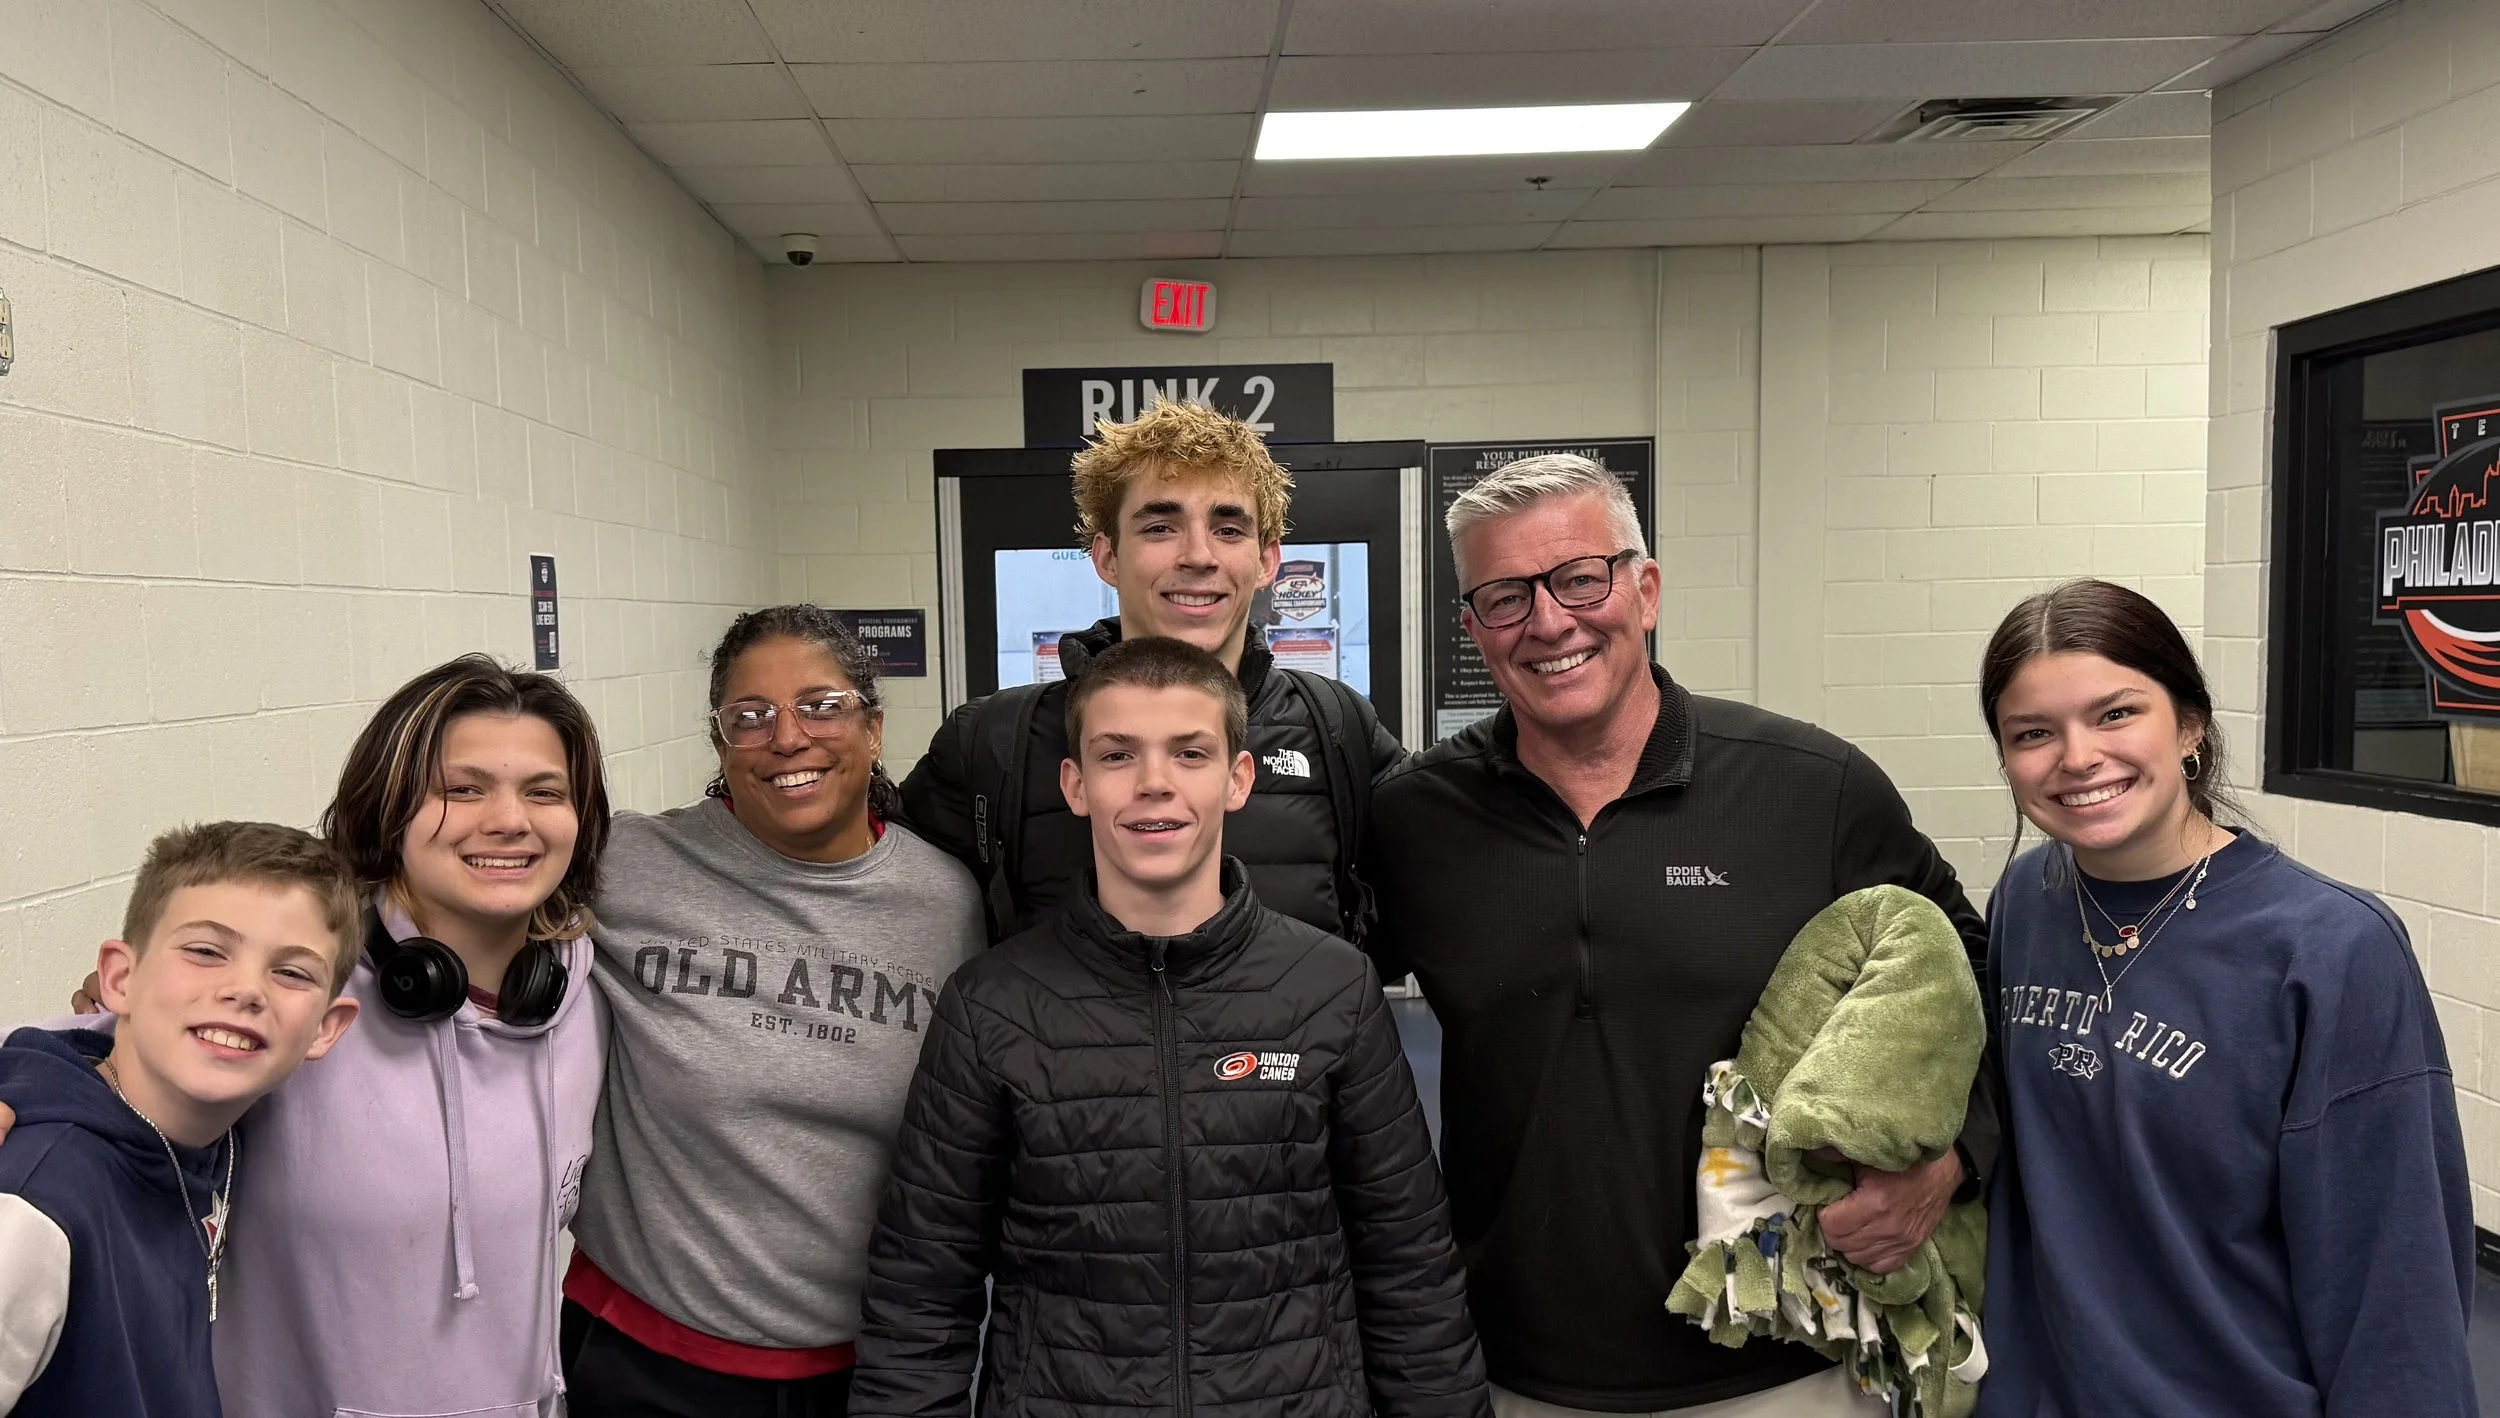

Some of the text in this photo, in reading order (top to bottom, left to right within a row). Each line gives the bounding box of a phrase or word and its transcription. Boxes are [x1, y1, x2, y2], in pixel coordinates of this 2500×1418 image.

[1152, 281, 1209, 328] EXIT
[1243, 375, 1275, 432] 2
[1482, 451, 1515, 461] YOUR
[2382, 520, 2500, 597] PHILAD
[1279, 590, 1318, 599] HOCKEY
[859, 625, 911, 638] PROGRAMS
[1278, 749, 1293, 758] THE
[1263, 756, 1294, 768] NORTH
[1272, 765, 1295, 775] FACE
[1666, 866, 1701, 875] EDDIE
[1666, 876, 1705, 886] BAUER
[720, 935, 786, 953] STATES
[797, 944, 879, 968] MILITARY
[633, 945, 757, 999] OLD
[750, 1012, 857, 1044] EST. 1802
[2001, 985, 2207, 1079] PUERTO RICO
[1258, 1052, 1299, 1067] JUNIOR
